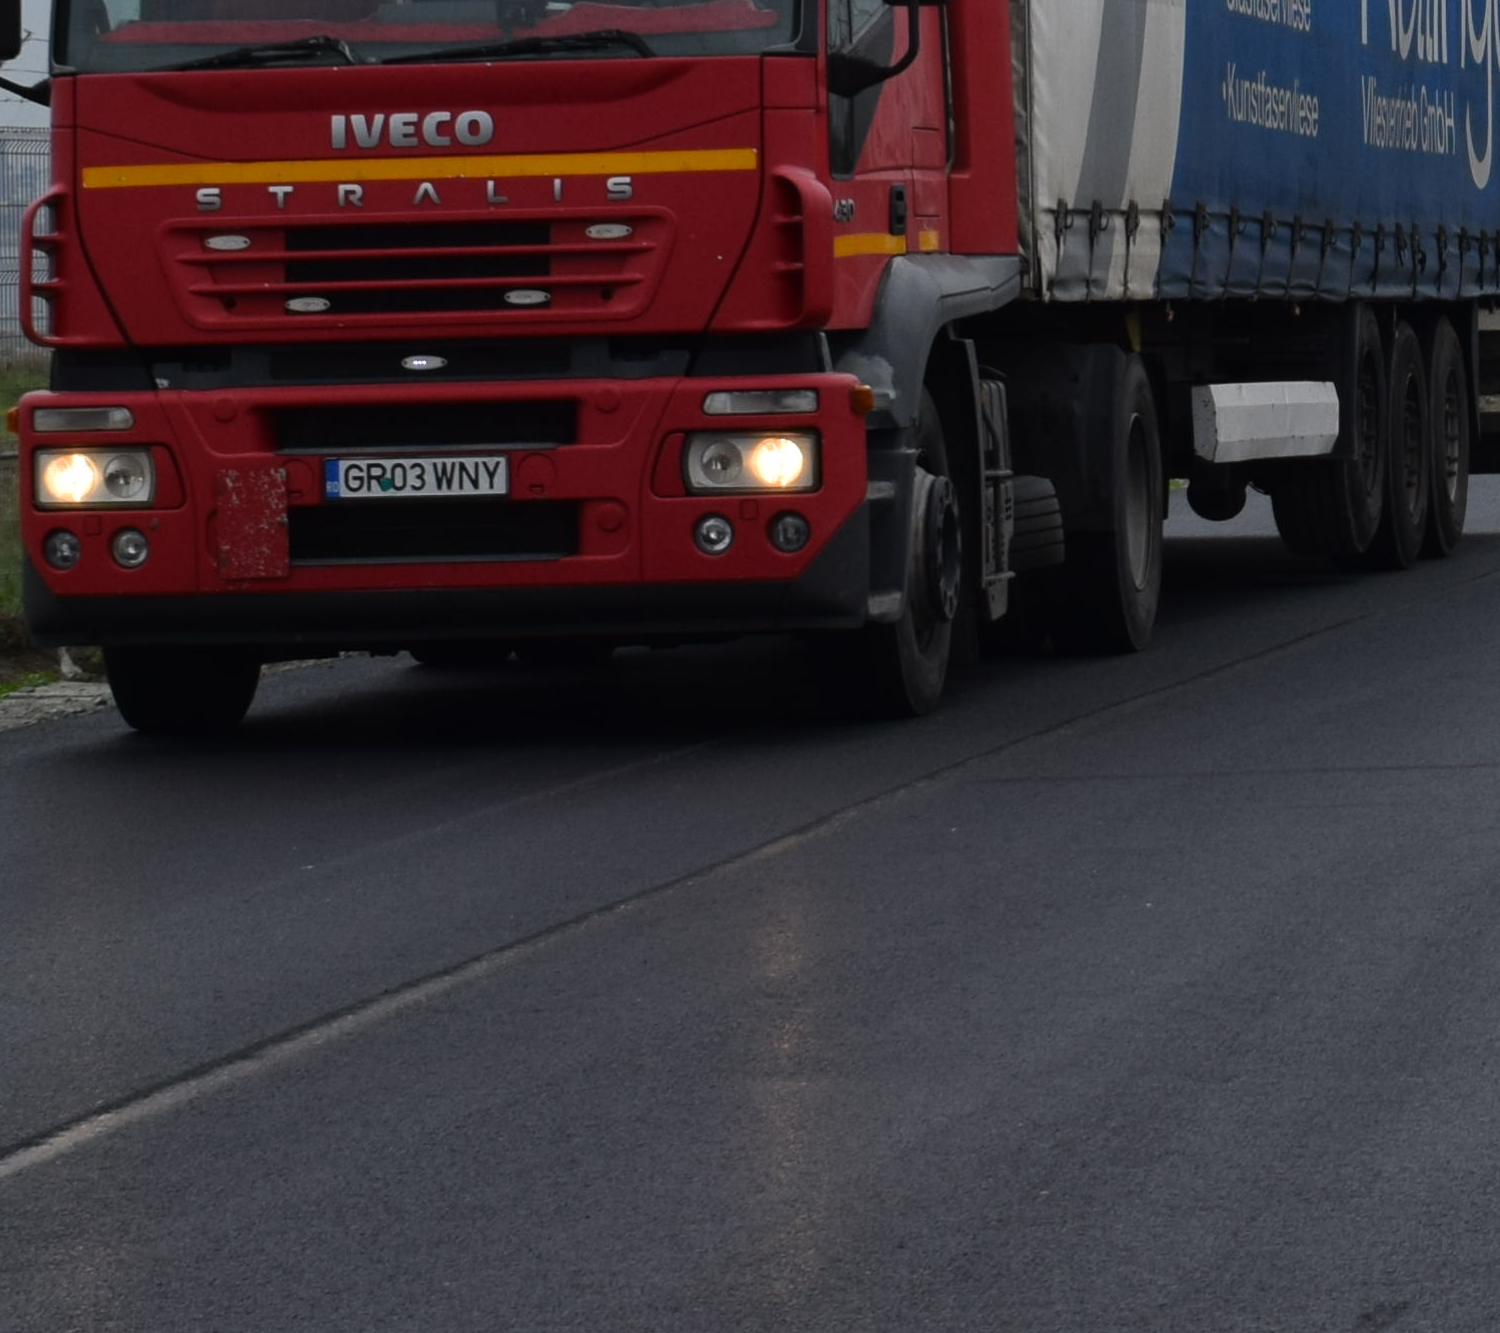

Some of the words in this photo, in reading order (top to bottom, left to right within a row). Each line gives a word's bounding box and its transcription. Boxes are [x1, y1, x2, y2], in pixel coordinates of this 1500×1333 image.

[1227, 62, 1319, 138] Kunstfaservliese
[1420, 85, 1456, 155] GmbH
[330, 110, 494, 150] IVECO
[196, 175, 633, 212] STRALIS
[432, 460, 501, 491] WNY
